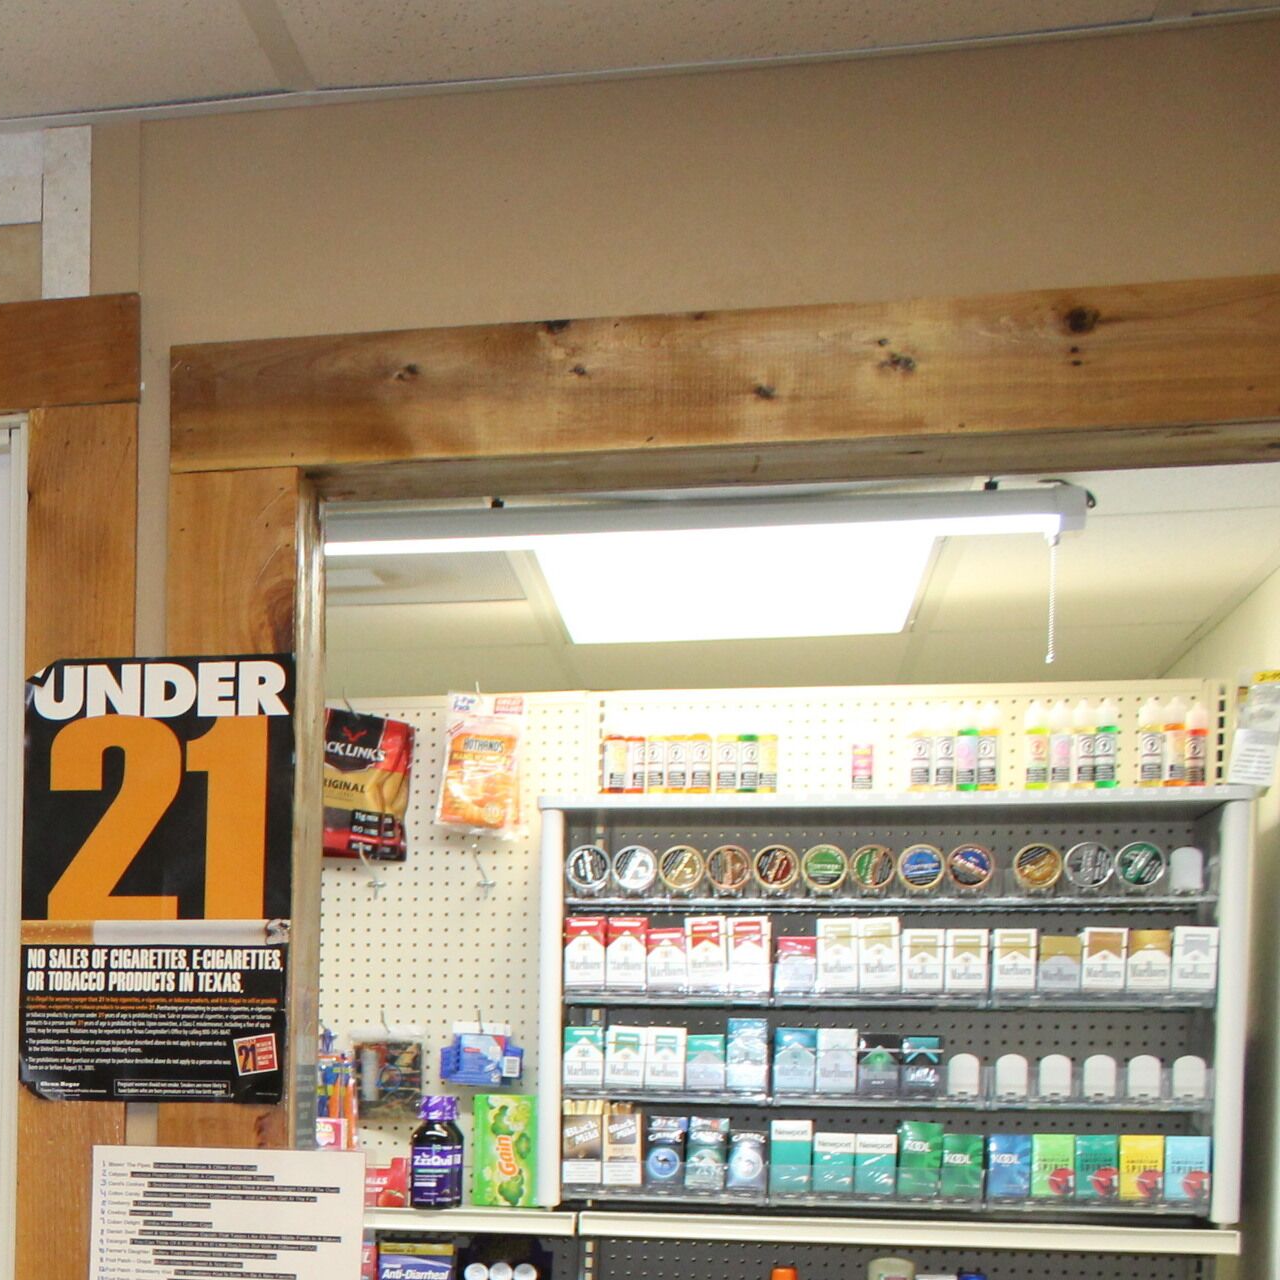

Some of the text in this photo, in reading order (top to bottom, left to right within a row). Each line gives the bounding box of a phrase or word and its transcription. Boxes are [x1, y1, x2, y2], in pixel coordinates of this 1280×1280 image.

[33, 660, 289, 721] UNDER
[47, 712, 268, 920] 21
[27, 948, 283, 972] NO SALES OF CIGARETTES, E-CIGARETTES,
[27, 971, 244, 993] OR TOBACCO PRODUCTS IN TEXAS.
[775, 1128, 808, 1137] Newport
[817, 1140, 851, 1150] Newport
[859, 1141, 893, 1150] Newport
[903, 1140, 932, 1152] KOOL
[496, 1135, 517, 1176] Gain
[943, 1153, 972, 1165] KOOL
[991, 1153, 1021, 1164] KOOL
[382, 1268, 449, 1280] Anti-Diarrheal
